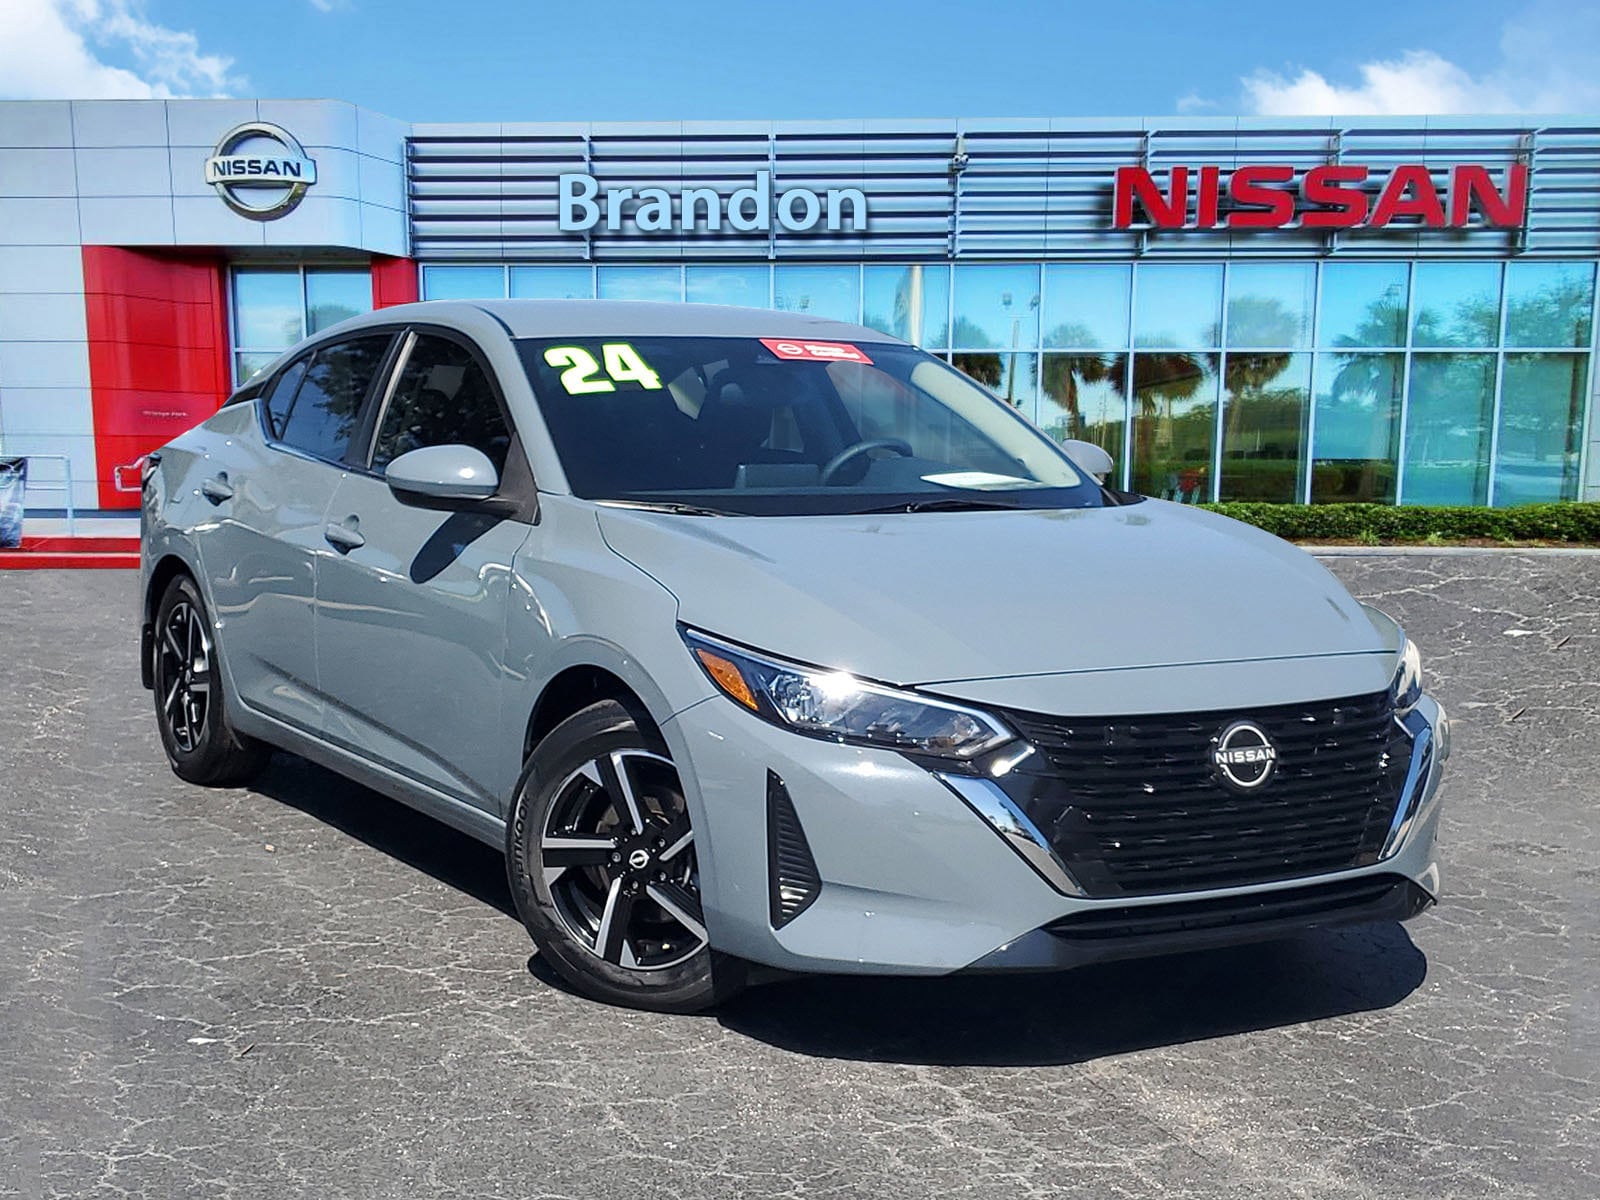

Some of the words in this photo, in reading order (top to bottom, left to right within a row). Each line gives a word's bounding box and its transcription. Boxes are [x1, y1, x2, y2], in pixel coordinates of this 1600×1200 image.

[213, 160, 301, 177] NISSAN
[559, 170, 867, 231] Brandon
[1113, 165, 1529, 229] NISSAN
[543, 343, 663, 395] 24
[1215, 747, 1276, 764] NISSAN
